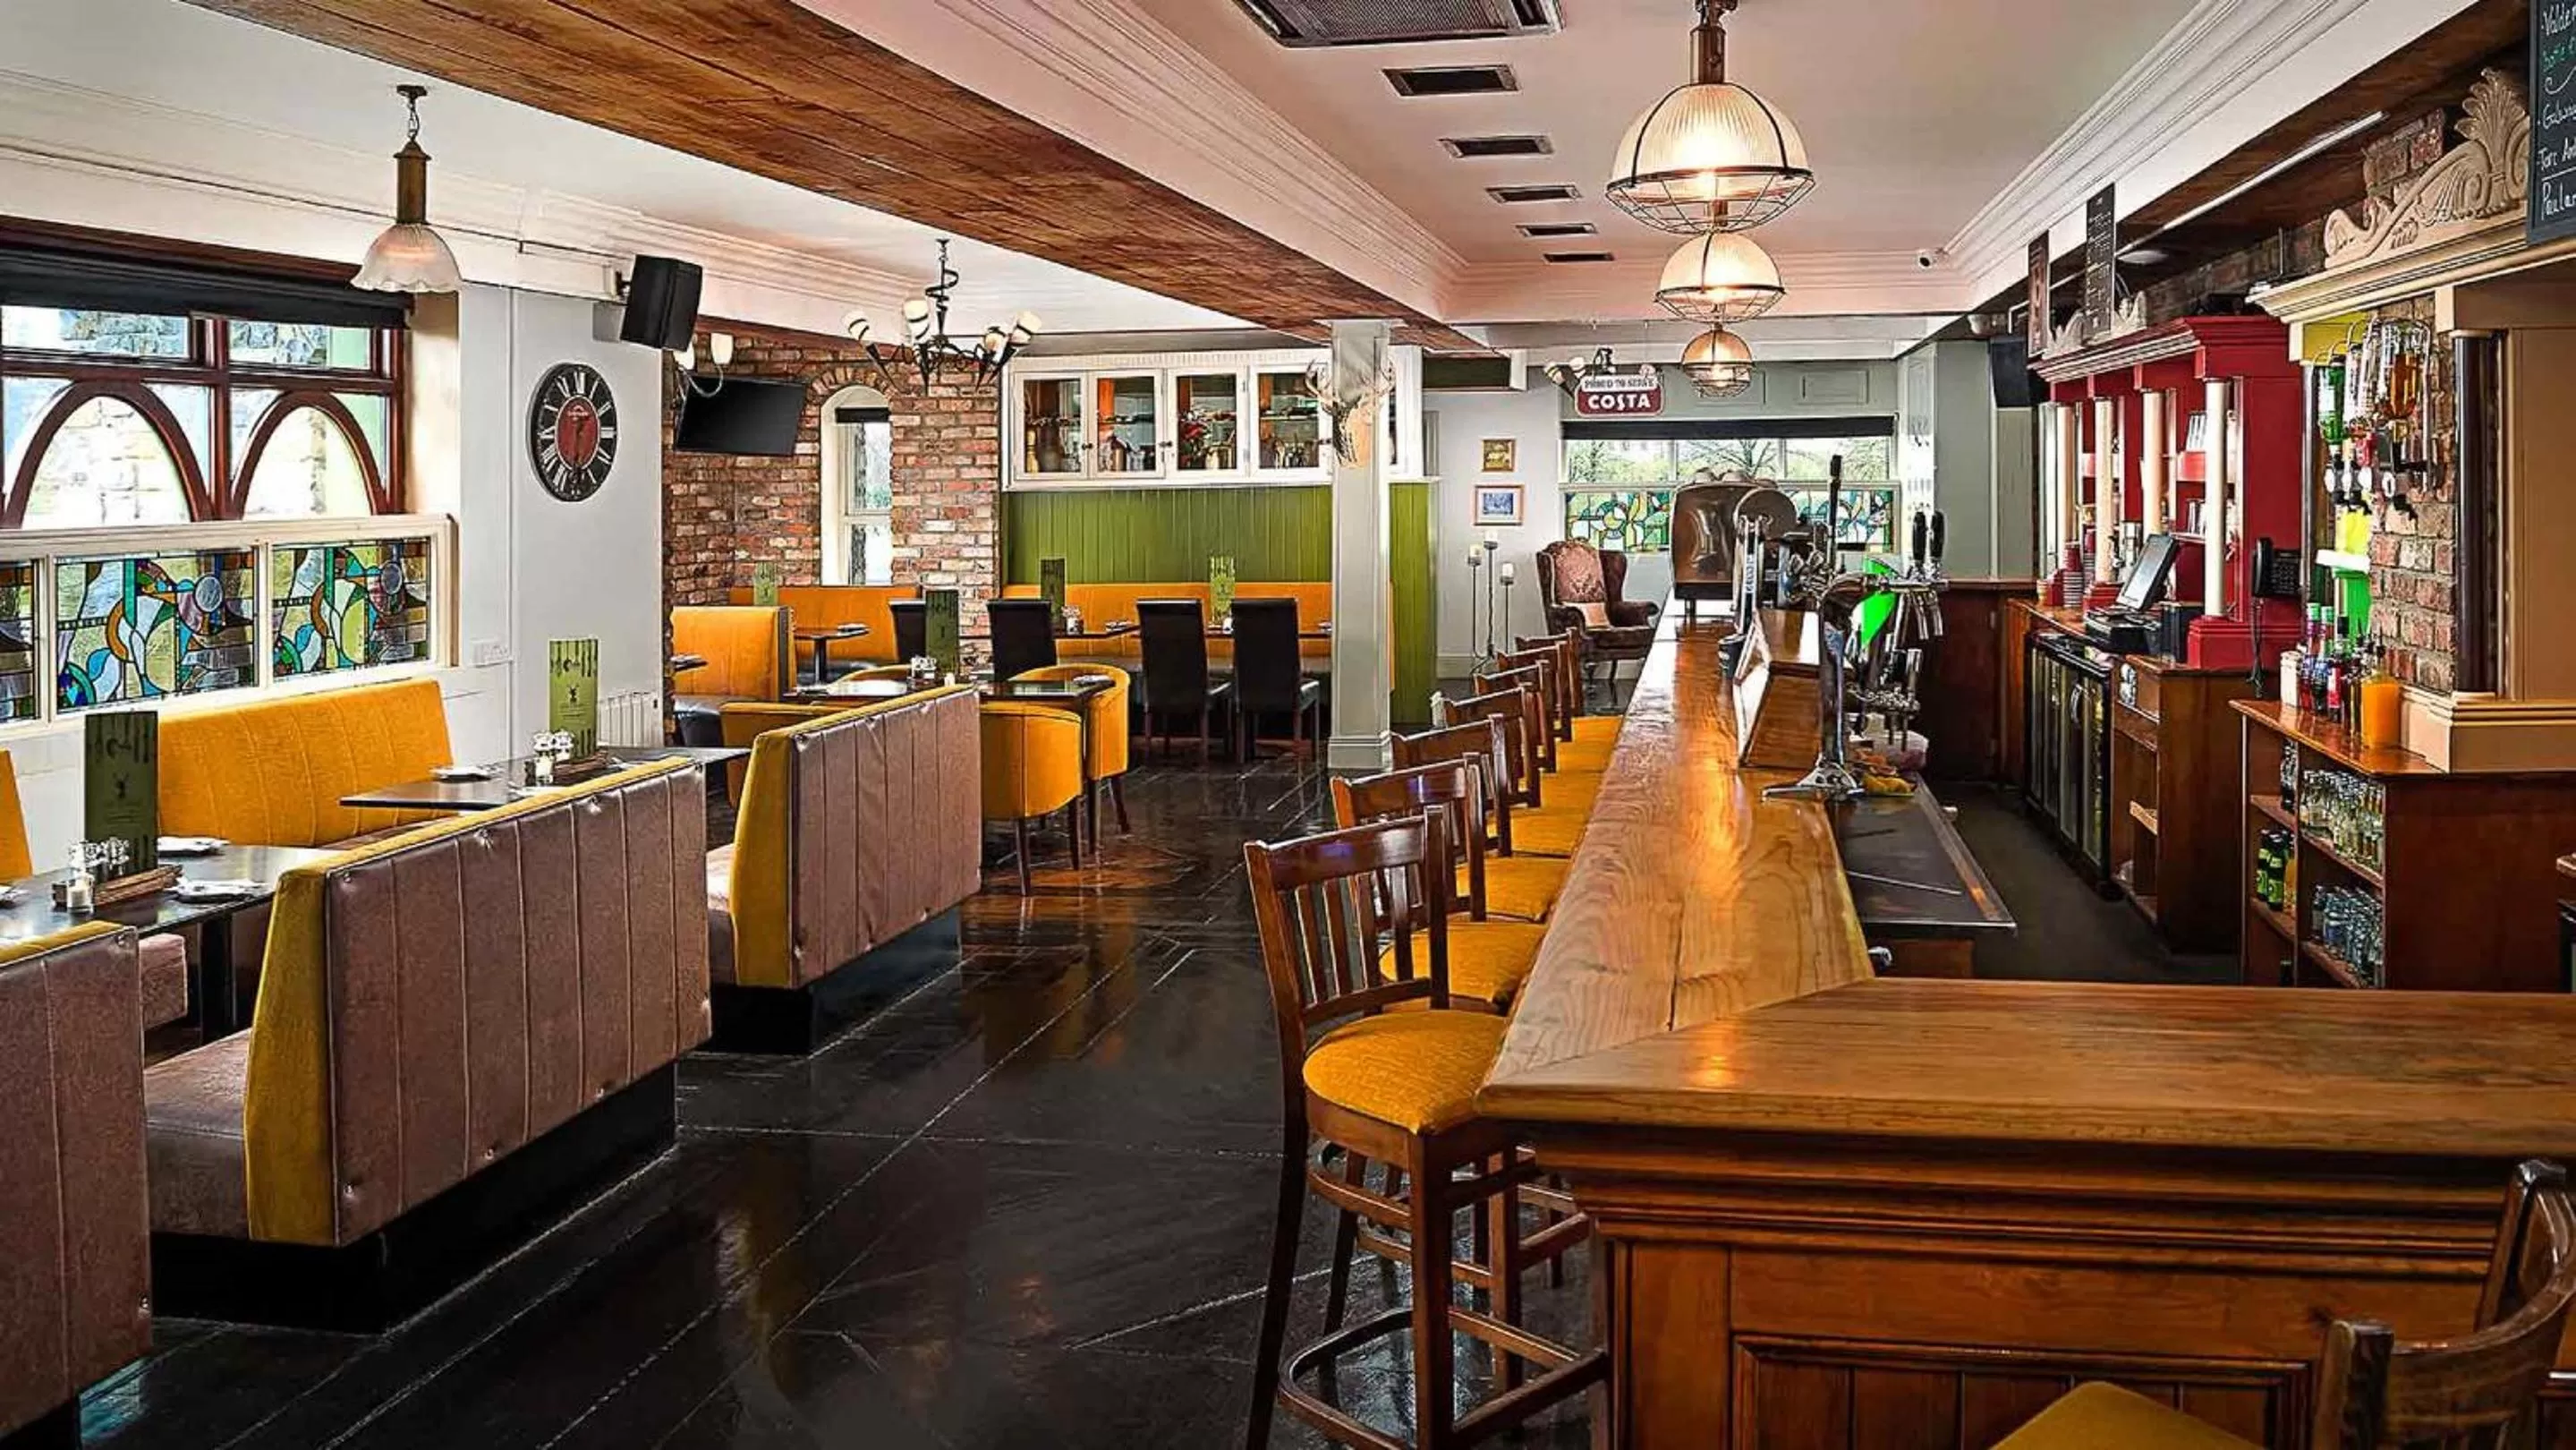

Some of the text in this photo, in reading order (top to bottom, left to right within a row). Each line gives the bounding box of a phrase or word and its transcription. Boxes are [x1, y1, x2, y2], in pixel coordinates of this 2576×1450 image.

[1585, 380, 1613, 388] PROUD
[1615, 380, 1626, 388] TO
[1588, 394, 1652, 411] COSTA
